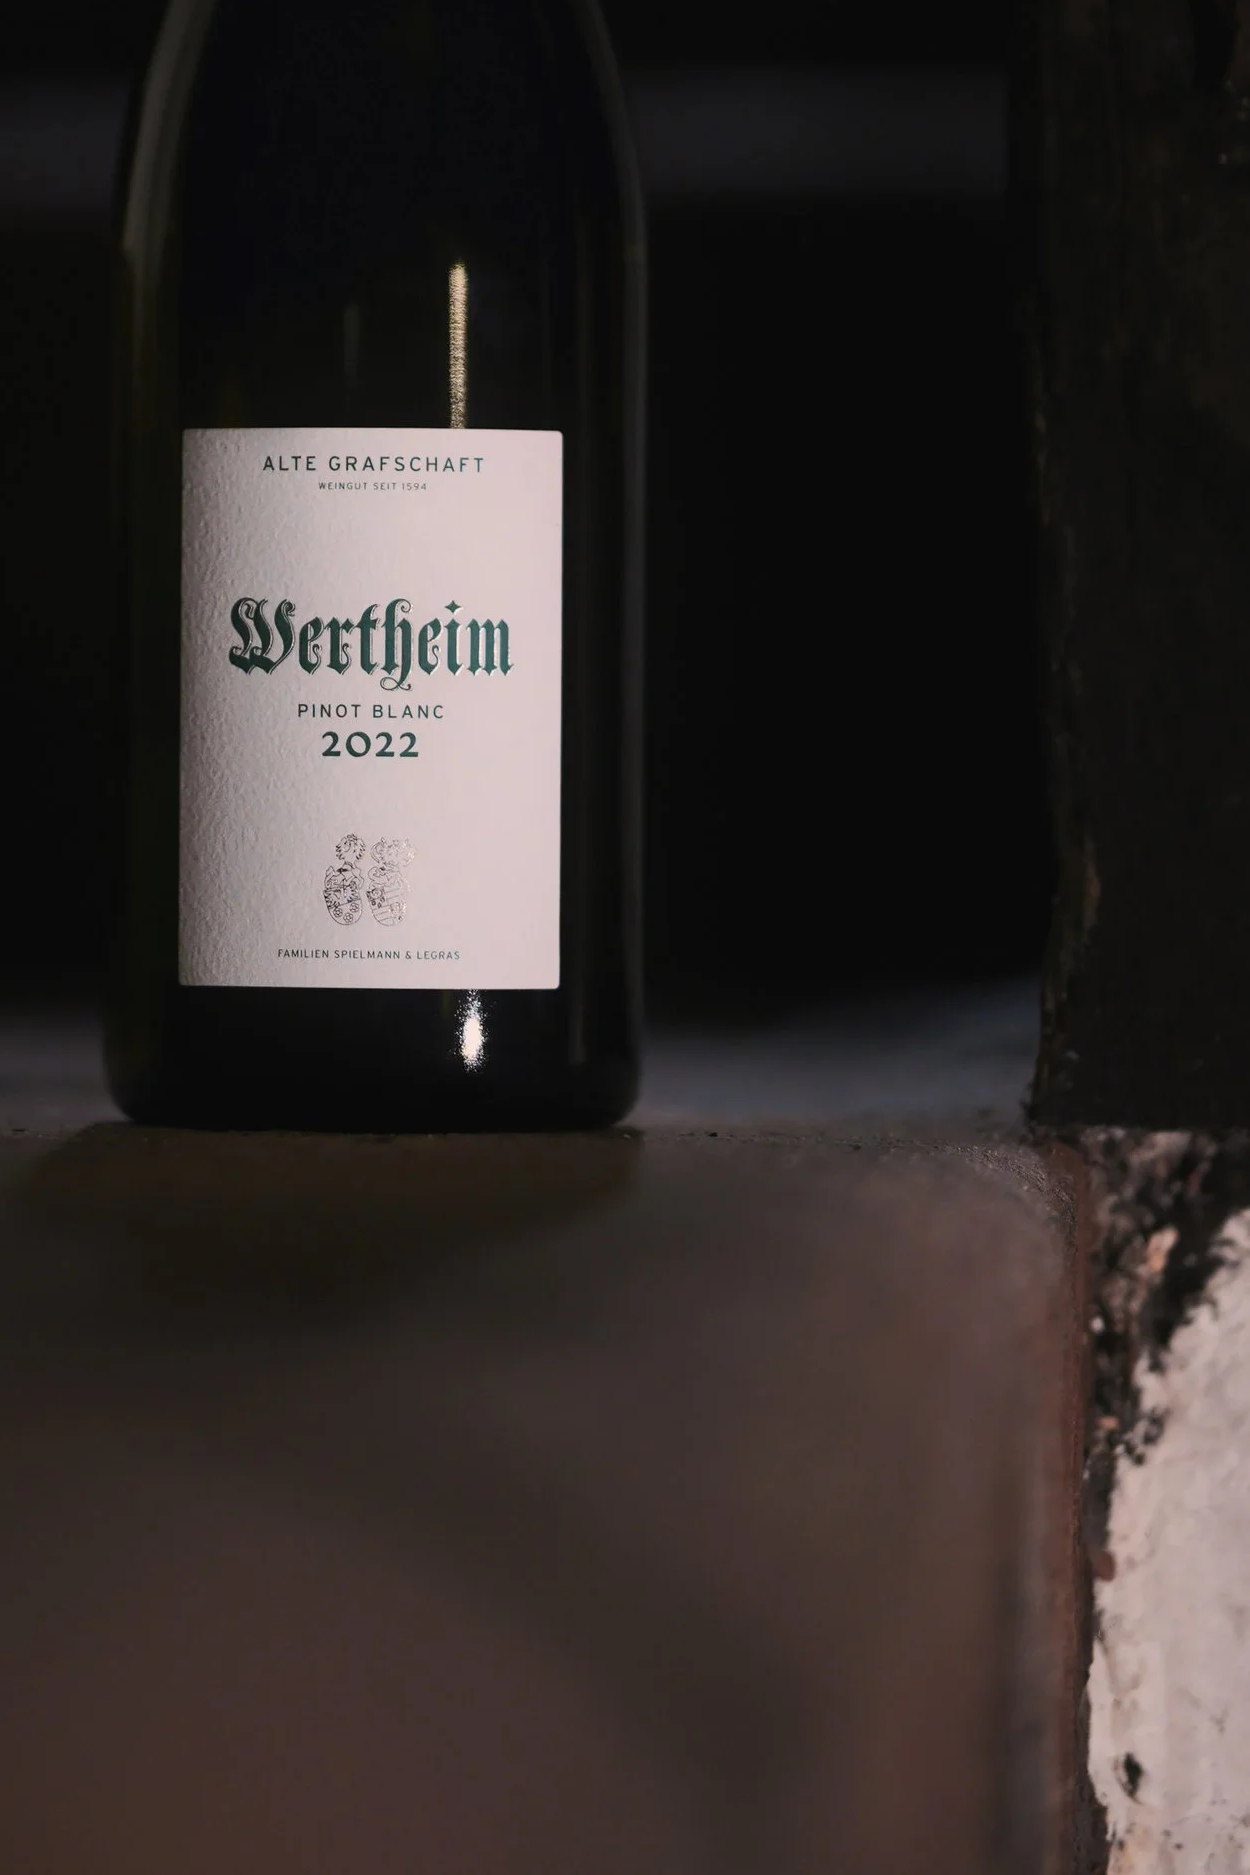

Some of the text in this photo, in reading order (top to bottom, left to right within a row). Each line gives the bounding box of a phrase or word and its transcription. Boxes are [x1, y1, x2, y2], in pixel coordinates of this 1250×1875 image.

[262, 455, 485, 474] ALTE GRAFSCHAFT
[318, 481, 428, 492] WEINGUT SEIT 1594
[228, 596, 514, 692] Wertheim
[297, 703, 445, 720] PINOT BLANC
[321, 730, 419, 758] 2022
[277, 948, 461, 961] FAMILIEN SPIELMANN & LEGRAS
